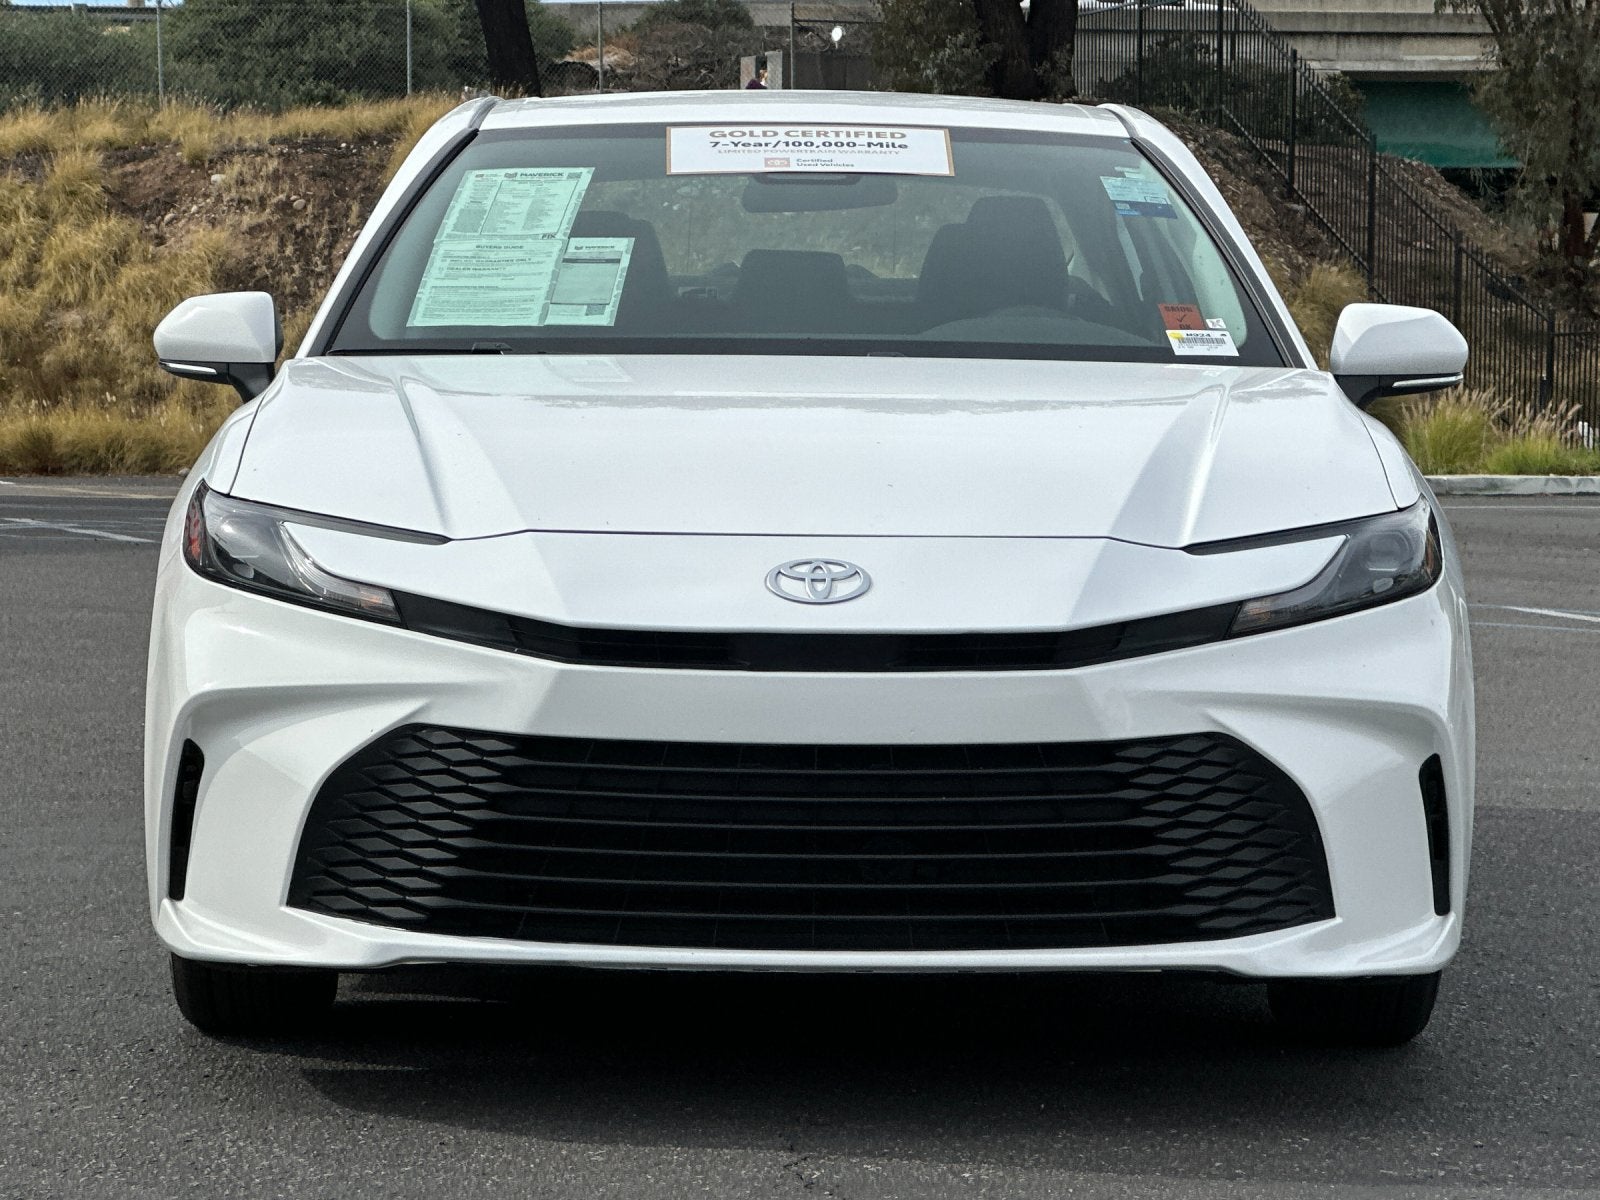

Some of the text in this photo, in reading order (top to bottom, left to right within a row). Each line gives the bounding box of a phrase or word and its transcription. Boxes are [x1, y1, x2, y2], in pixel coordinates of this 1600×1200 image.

[709, 130, 907, 139] GOLD CERTIFIED
[709, 140, 909, 149] 7-Year/100,000-Mile
